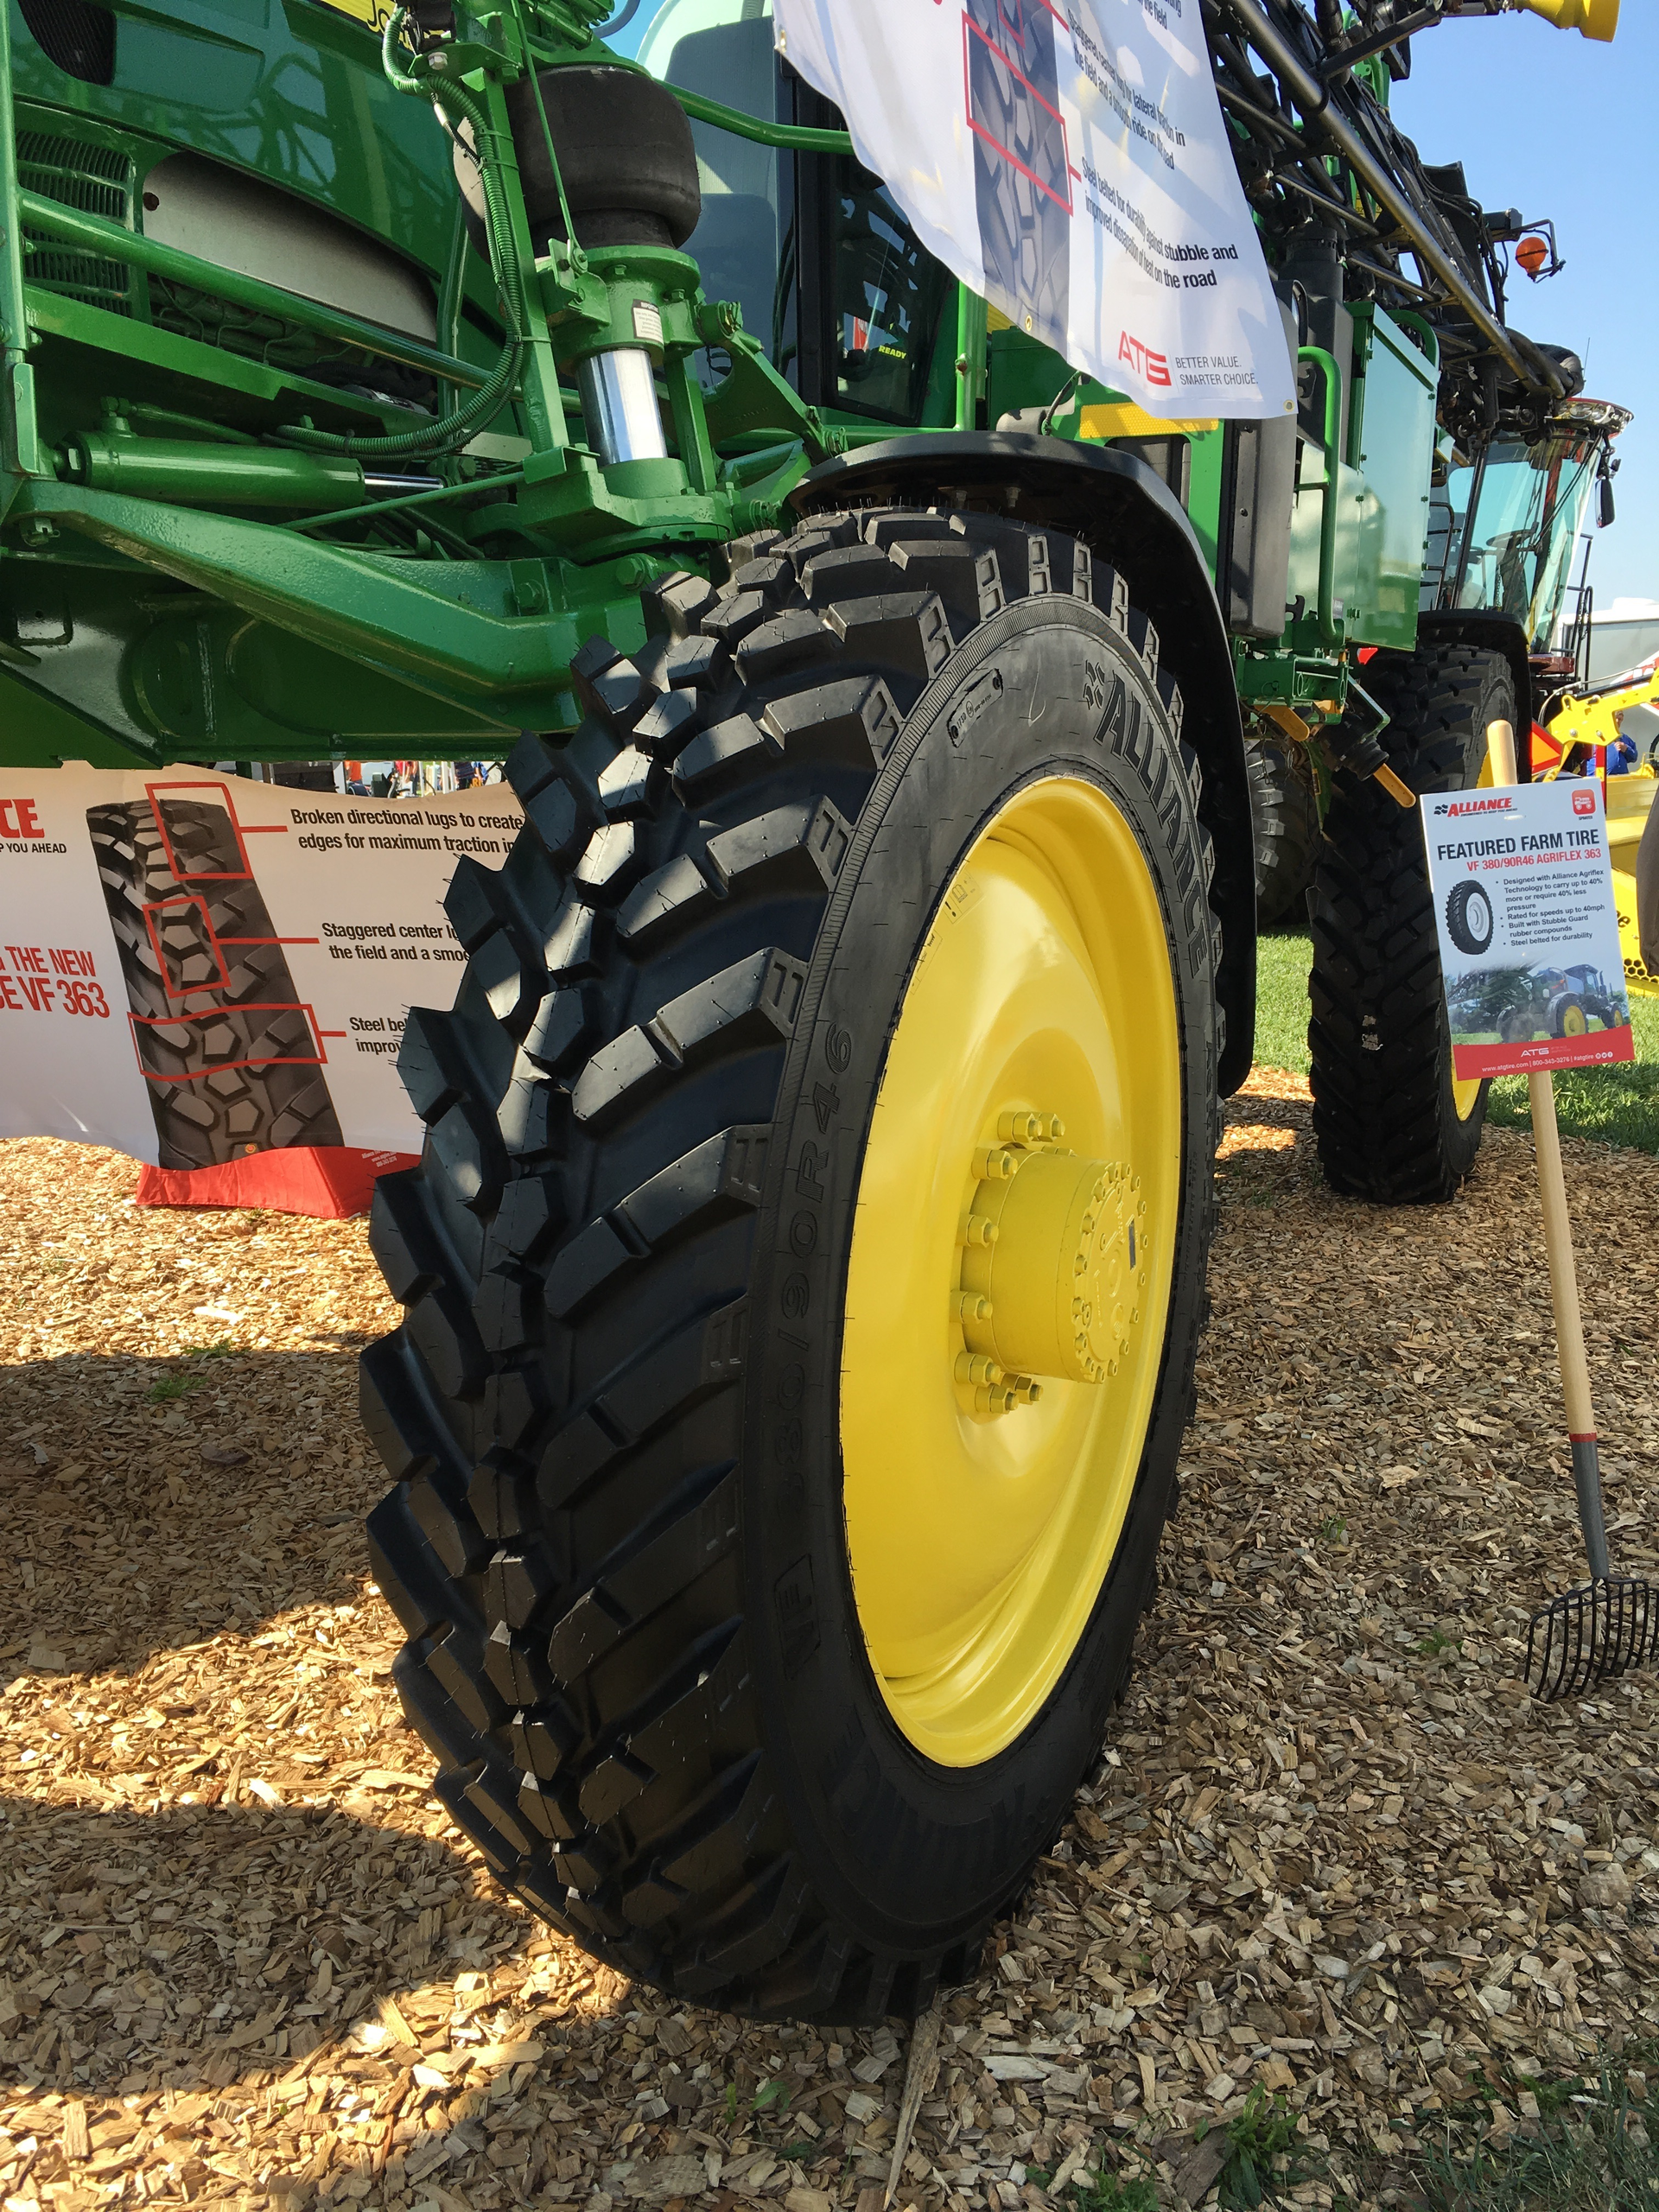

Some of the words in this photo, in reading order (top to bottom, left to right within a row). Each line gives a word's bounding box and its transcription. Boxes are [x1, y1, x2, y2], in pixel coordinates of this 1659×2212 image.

[1154, 1, 1167, 30] field
[1068, 8, 1099, 61] Staggered
[1098, 50, 1116, 84] center
[1133, 89, 1158, 121] lateral
[1175, 126, 1186, 147] in
[1073, 41, 1084, 71] the
[1084, 54, 1097, 87] field
[1097, 75, 1109, 102] and
[1109, 89, 1114, 106] a
[1131, 116, 1147, 140] ride
[1147, 129, 1157, 148] on
[1082, 156, 1097, 189] Steel
[1096, 172, 1116, 207] belted
[1116, 189, 1126, 214] for
[1126, 199, 1147, 243] durability
[1146, 226, 1164, 257] against
[1164, 242, 1210, 262] stubble
[1211, 244, 1239, 260] and
[1084, 189, 1113, 234] improved
[1143, 251, 1154, 279] heat
[1154, 264, 1163, 284] on
[1163, 268, 1181, 289] the
[1183, 270, 1218, 289] road
[878, 344, 906, 359] READY
[1175, 356, 1209, 369] BETTER
[1211, 355, 1242, 368] VALUE.
[1179, 373, 1223, 385] SMARTER
[1224, 372, 1259, 385] CHOICE.
[1447, 797, 1512, 817] ALLIANCE
[290, 808, 344, 824] Broken
[346, 809, 422, 825] directional
[425, 810, 457, 830] lugs
[459, 813, 475, 827] to
[478, 814, 524, 830] create
[1094, 670, 1208, 978] ALLIANCE
[6, 842, 29, 853] YOU
[32, 842, 67, 854] AHEAD
[298, 834, 343, 852] edges
[345, 833, 365, 849] for
[369, 835, 442, 851] maximum
[443, 835, 500, 854] traction
[1438, 837, 1516, 861] FEATURED
[1521, 833, 1563, 851] FARM
[1567, 829, 1600, 847] TIRE
[1466, 861, 1479, 872] VF
[1482, 855, 1535, 871] 380/90R46
[1536, 850, 1581, 865] AGRIFLEX
[1585, 848, 1602, 860] 363
[1503, 876, 1535, 886] Designed
[1552, 872, 1578, 880] Alliance
[1579, 869, 1604, 879] Agriflex
[1504, 885, 1543, 893] Technology
[1553, 881, 1570, 891] carry
[1533, 891, 1556, 900] require
[1506, 903, 1536, 912] pressure
[1508, 912, 1528, 920] Rated
[1540, 908, 1564, 918] speeds
[1583, 904, 1605, 912] 40mph
[321, 922, 396, 940] Staggered
[399, 925, 443, 939] center
[1509, 920, 1525, 929] Built
[1541, 917, 1567, 925] Stubble
[1534, 925, 1573, 935] compounds
[1529, 936, 1550, 944] belted
[1562, 932, 1592, 941] durability
[4, 946, 49, 973] THE
[48, 948, 97, 977] NEW
[329, 945, 353, 959] the
[355, 945, 387, 960] field
[391, 946, 416, 961] and
[421, 950, 430, 961] a
[16, 976, 55, 1013] VF
[56, 979, 110, 1018] 363
[349, 1016, 385, 1032] Steel
[1521, 1047, 1549, 1057] ATG
[1482, 1062, 1529, 1072] www.atgtire.com
[1532, 1056, 1570, 1066] 800-343-3276
[1573, 1053, 1594, 1063] #atgtire
